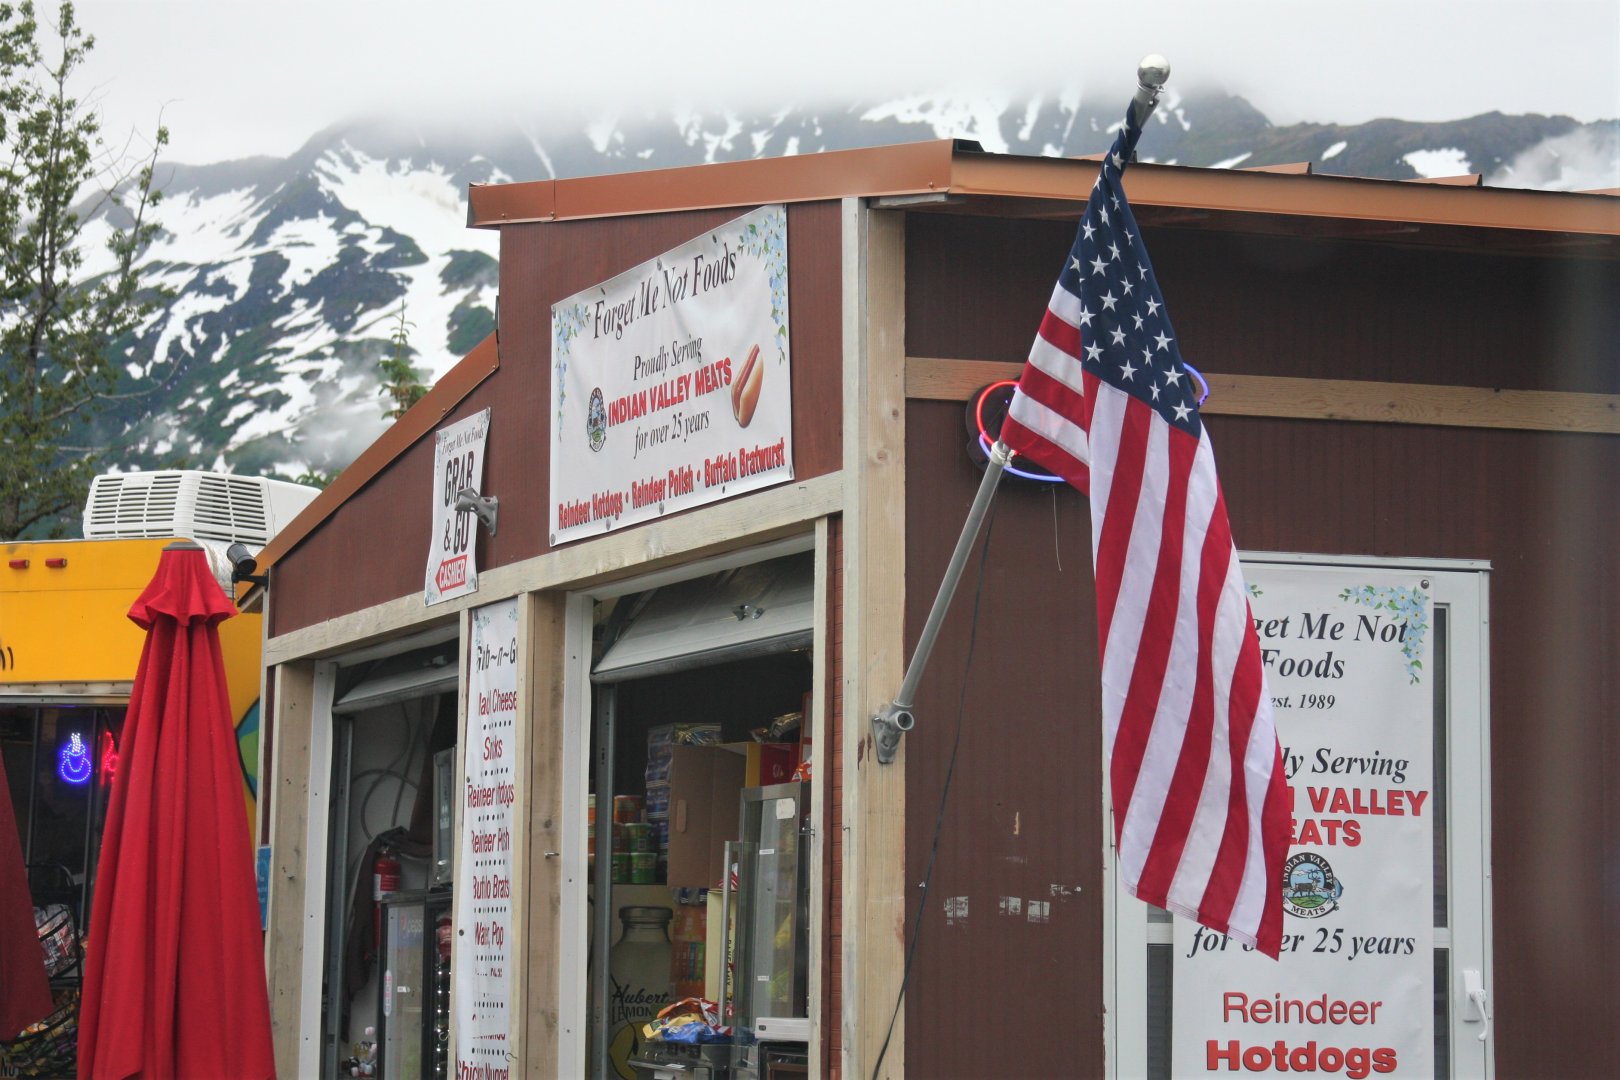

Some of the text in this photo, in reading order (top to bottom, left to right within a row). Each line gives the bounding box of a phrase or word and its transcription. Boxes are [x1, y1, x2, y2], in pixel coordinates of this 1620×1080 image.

[593, 242, 737, 340] Forget Me Not Foods
[633, 336, 702, 381] Proudly Serving
[608, 387, 648, 427] INDIAN
[650, 375, 691, 411] VALLEY
[694, 357, 732, 397] MEATS
[633, 411, 710, 460] for over 25 years
[558, 437, 785, 530] Reindeer Hotdogs Reindeer Polish Buffalo Bratwurst
[444, 510, 470, 555] & GO
[440, 558, 467, 588] CASHIER
[1297, 612, 1345, 641] Me
[1354, 614, 1408, 643] Not
[1259, 648, 1345, 679] Foods
[1298, 694, 1336, 710] 1989
[1311, 746, 1409, 784] Serving
[1306, 786, 1429, 817] VALLEY
[1289, 818, 1361, 847] EATS
[1309, 854, 1333, 884] VALLEY
[1291, 905, 1326, 917] MEATS
[492, 920, 504, 950] Pop
[1186, 926, 1233, 958] for
[1312, 927, 1344, 954] 25
[1347, 934, 1416, 961] years
[1222, 991, 1383, 1025] Reindeer
[1206, 1039, 1398, 1080] Hotdogs
